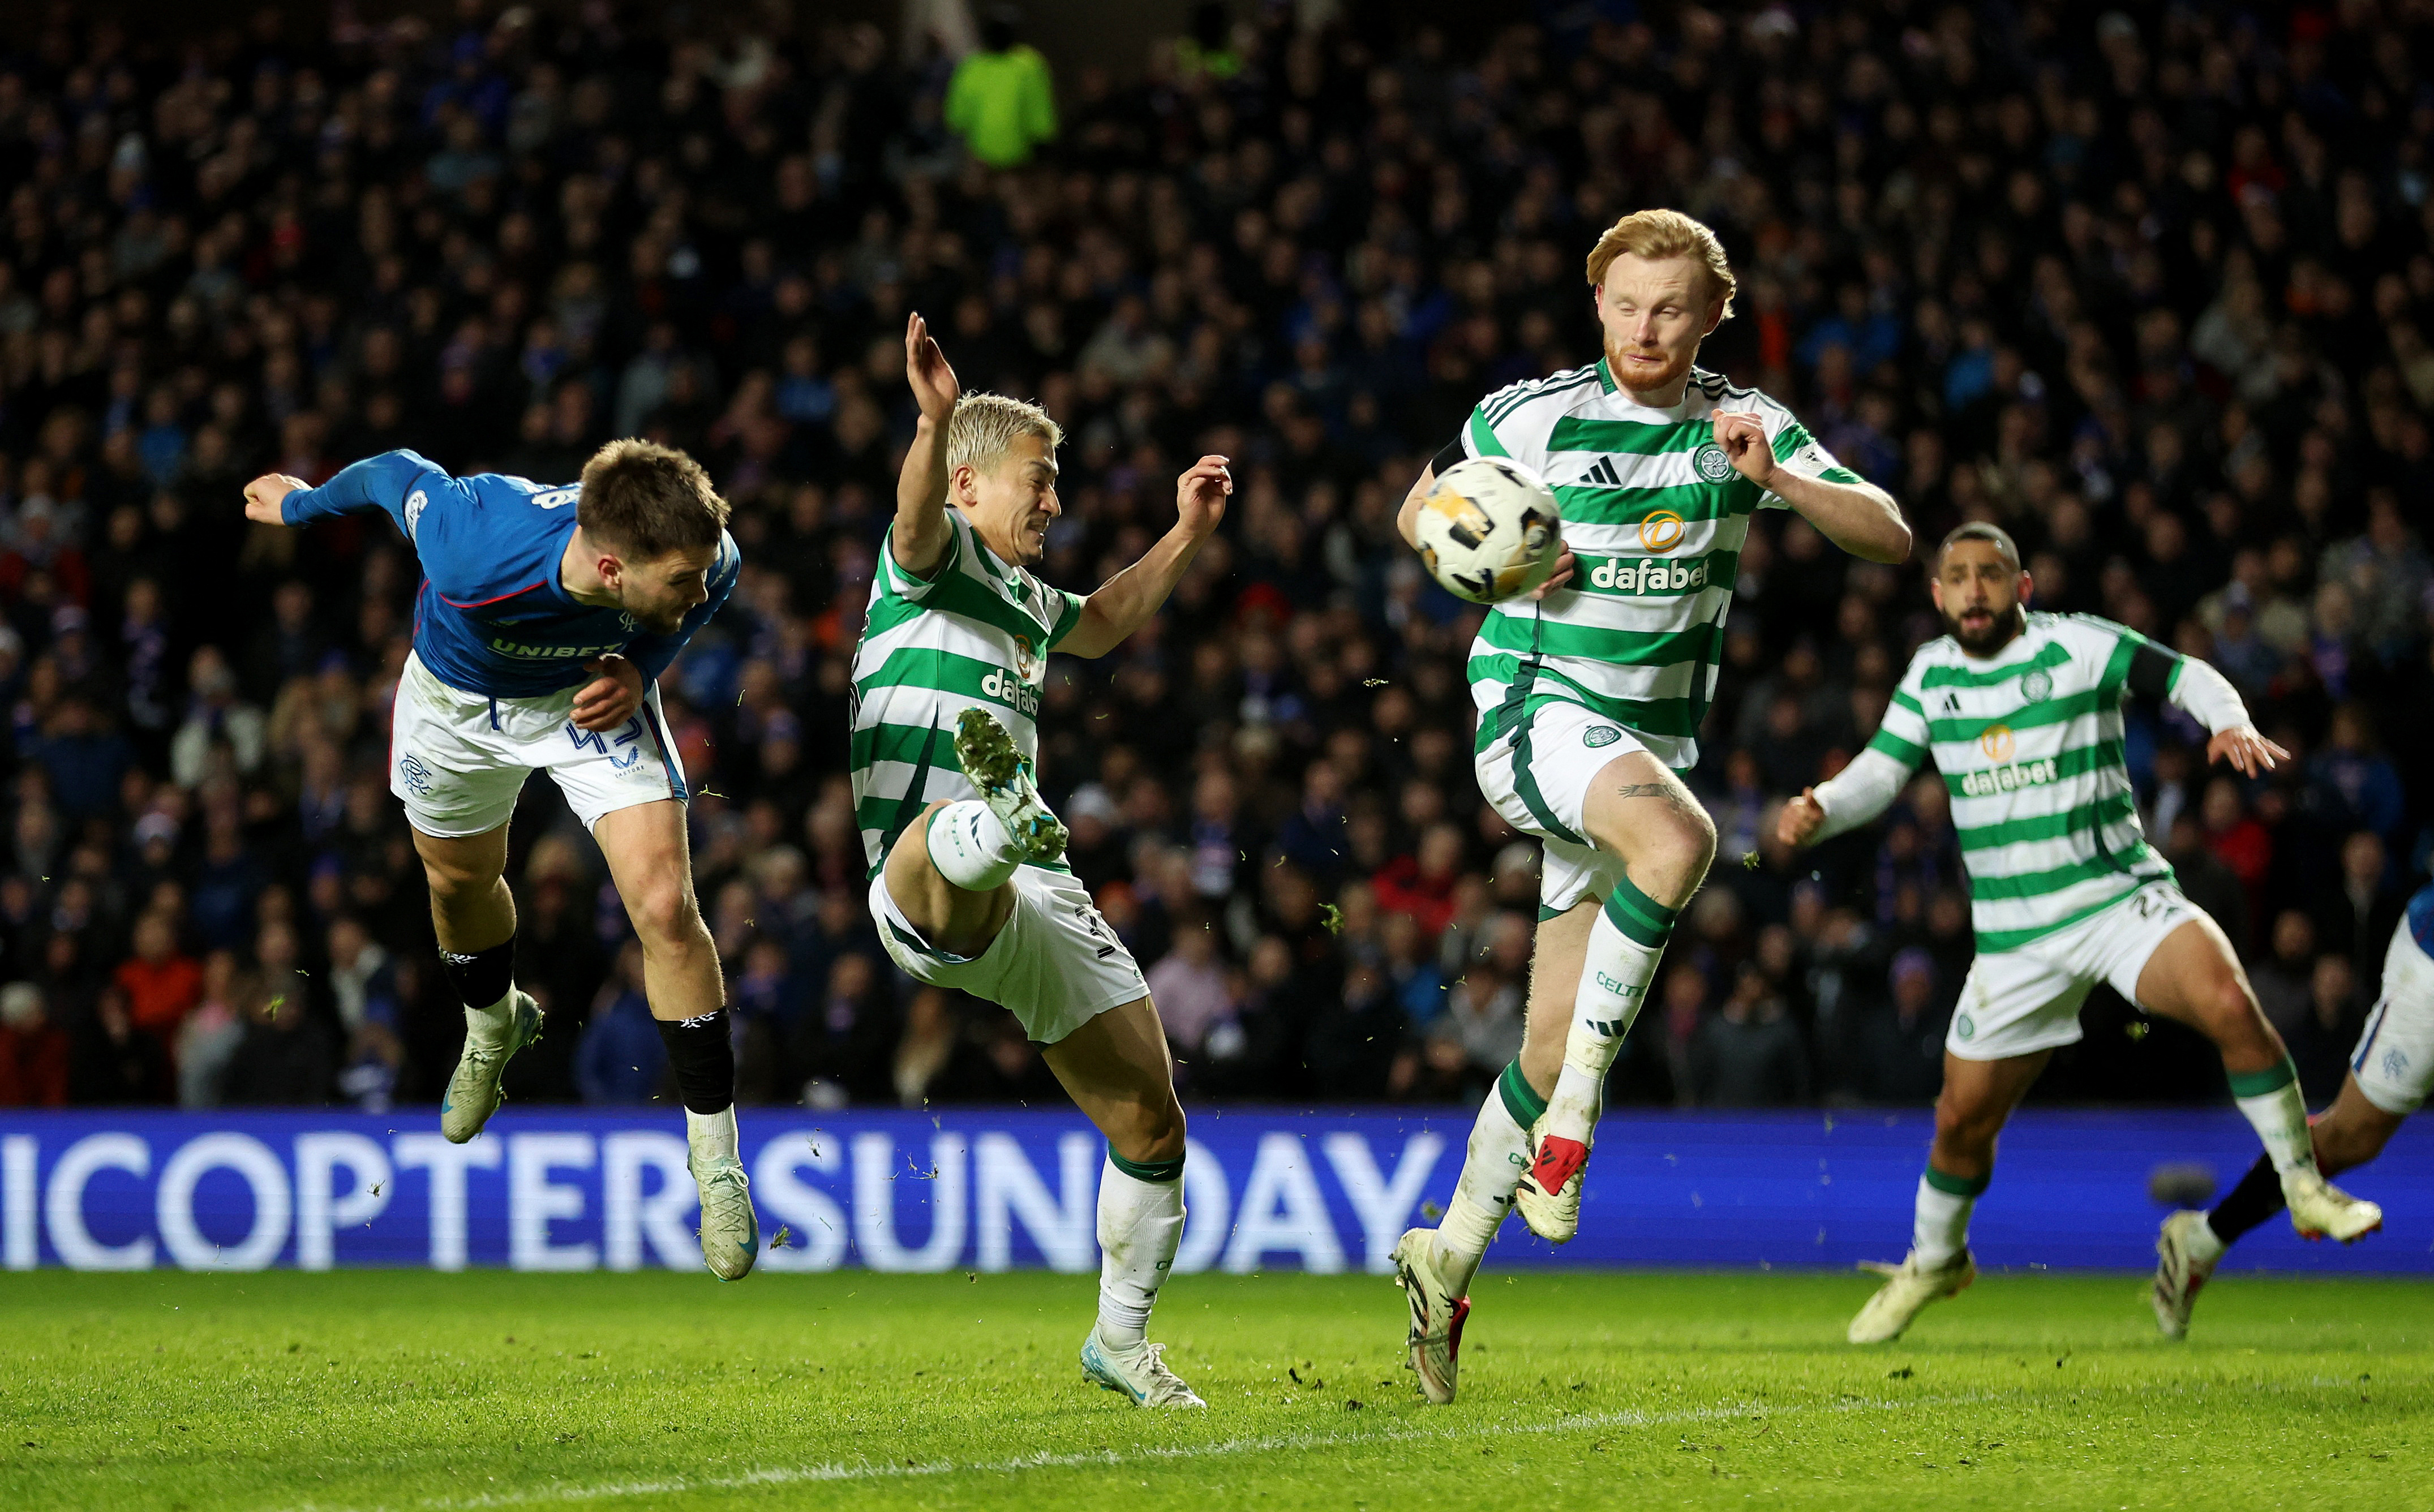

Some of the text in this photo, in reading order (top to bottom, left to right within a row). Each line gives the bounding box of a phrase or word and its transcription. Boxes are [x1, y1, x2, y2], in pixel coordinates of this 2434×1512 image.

[1591, 558, 1710, 595] dafabet
[493, 638, 622, 658] UNIBET
[615, 764, 645, 779] CASTORE
[1961, 758, 2059, 797] dafabet
[2, 1133, 703, 1272] ICOPTER
